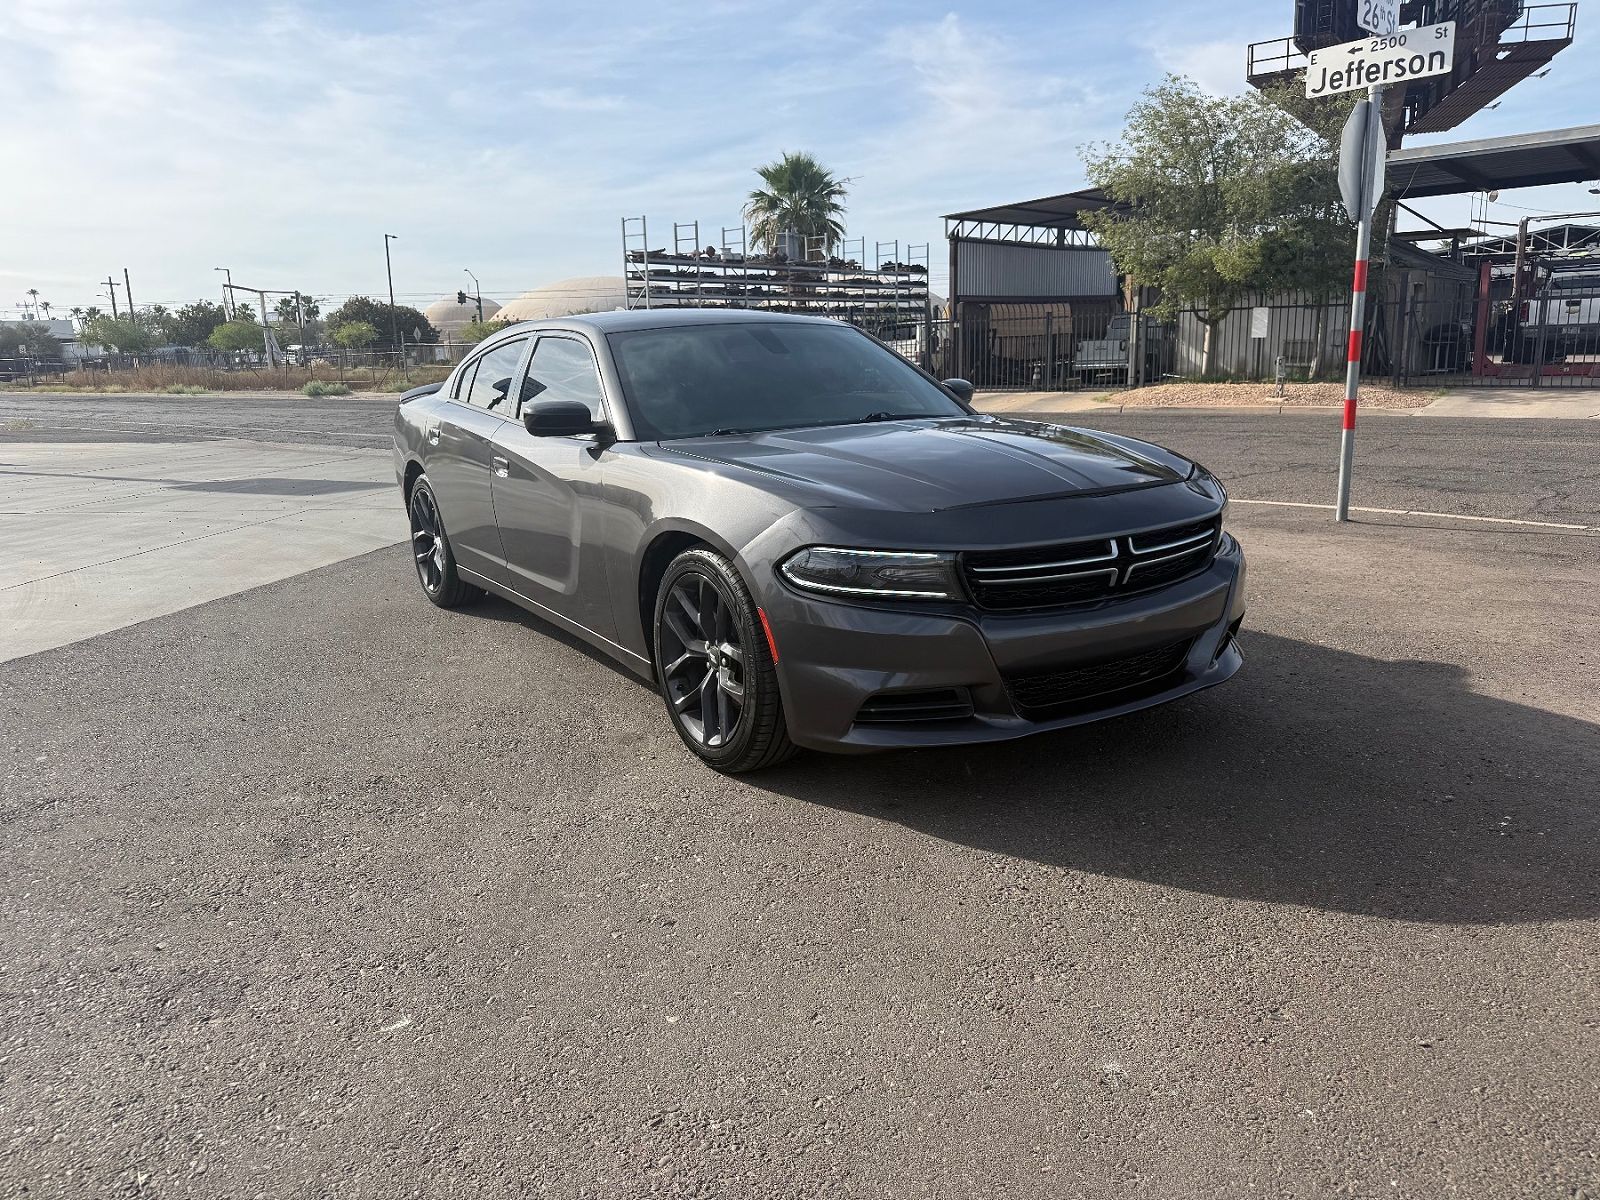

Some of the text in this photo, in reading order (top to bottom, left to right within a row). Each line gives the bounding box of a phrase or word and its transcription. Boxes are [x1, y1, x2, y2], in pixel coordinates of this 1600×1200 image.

[1386, 10, 1396, 34] St
[1311, 26, 1449, 65] E 2500 St
[1311, 50, 1445, 94] Jefferson
